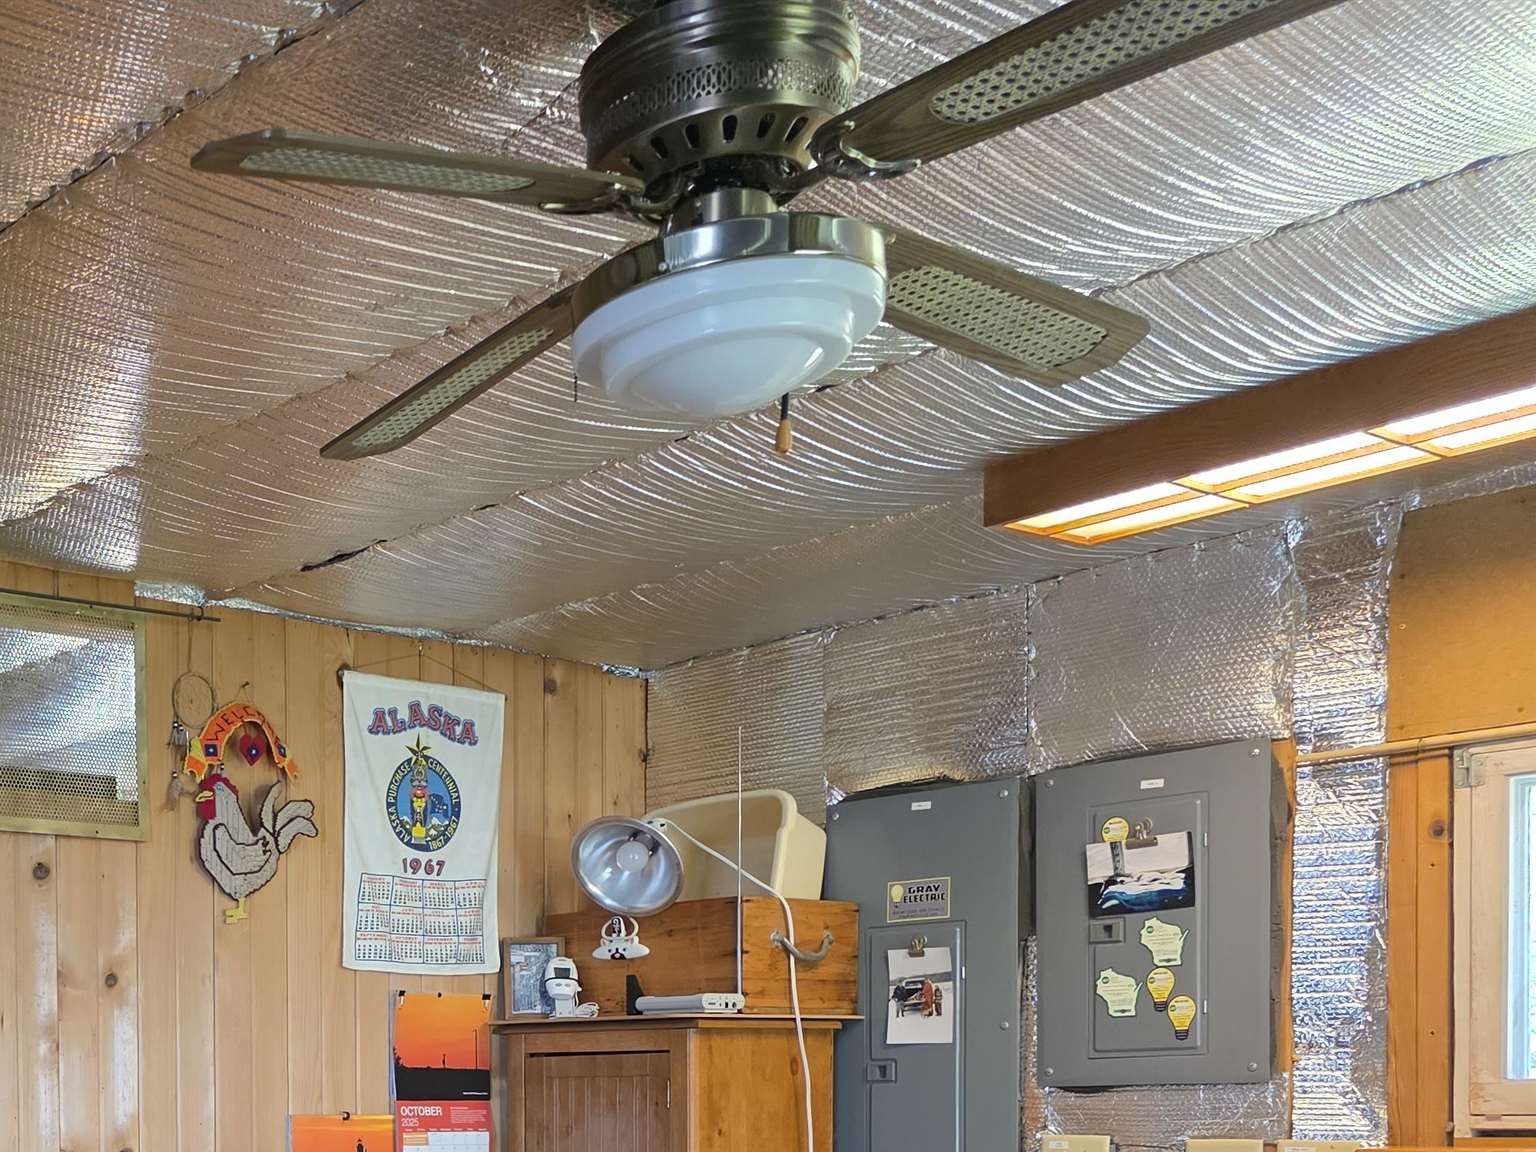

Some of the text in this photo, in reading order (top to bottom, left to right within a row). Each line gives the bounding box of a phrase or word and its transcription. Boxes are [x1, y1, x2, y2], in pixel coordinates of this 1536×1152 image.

[368, 700, 479, 746] ALASKA
[387, 758, 459, 843] ALASKA PURCHASE CENTENNIAL
[402, 857, 446, 877] 1967
[908, 884, 941, 895] GRAY
[903, 892, 945, 904] ELECTRIC
[400, 1106, 443, 1117] OCTOBER
[401, 1117, 420, 1127] 2025
